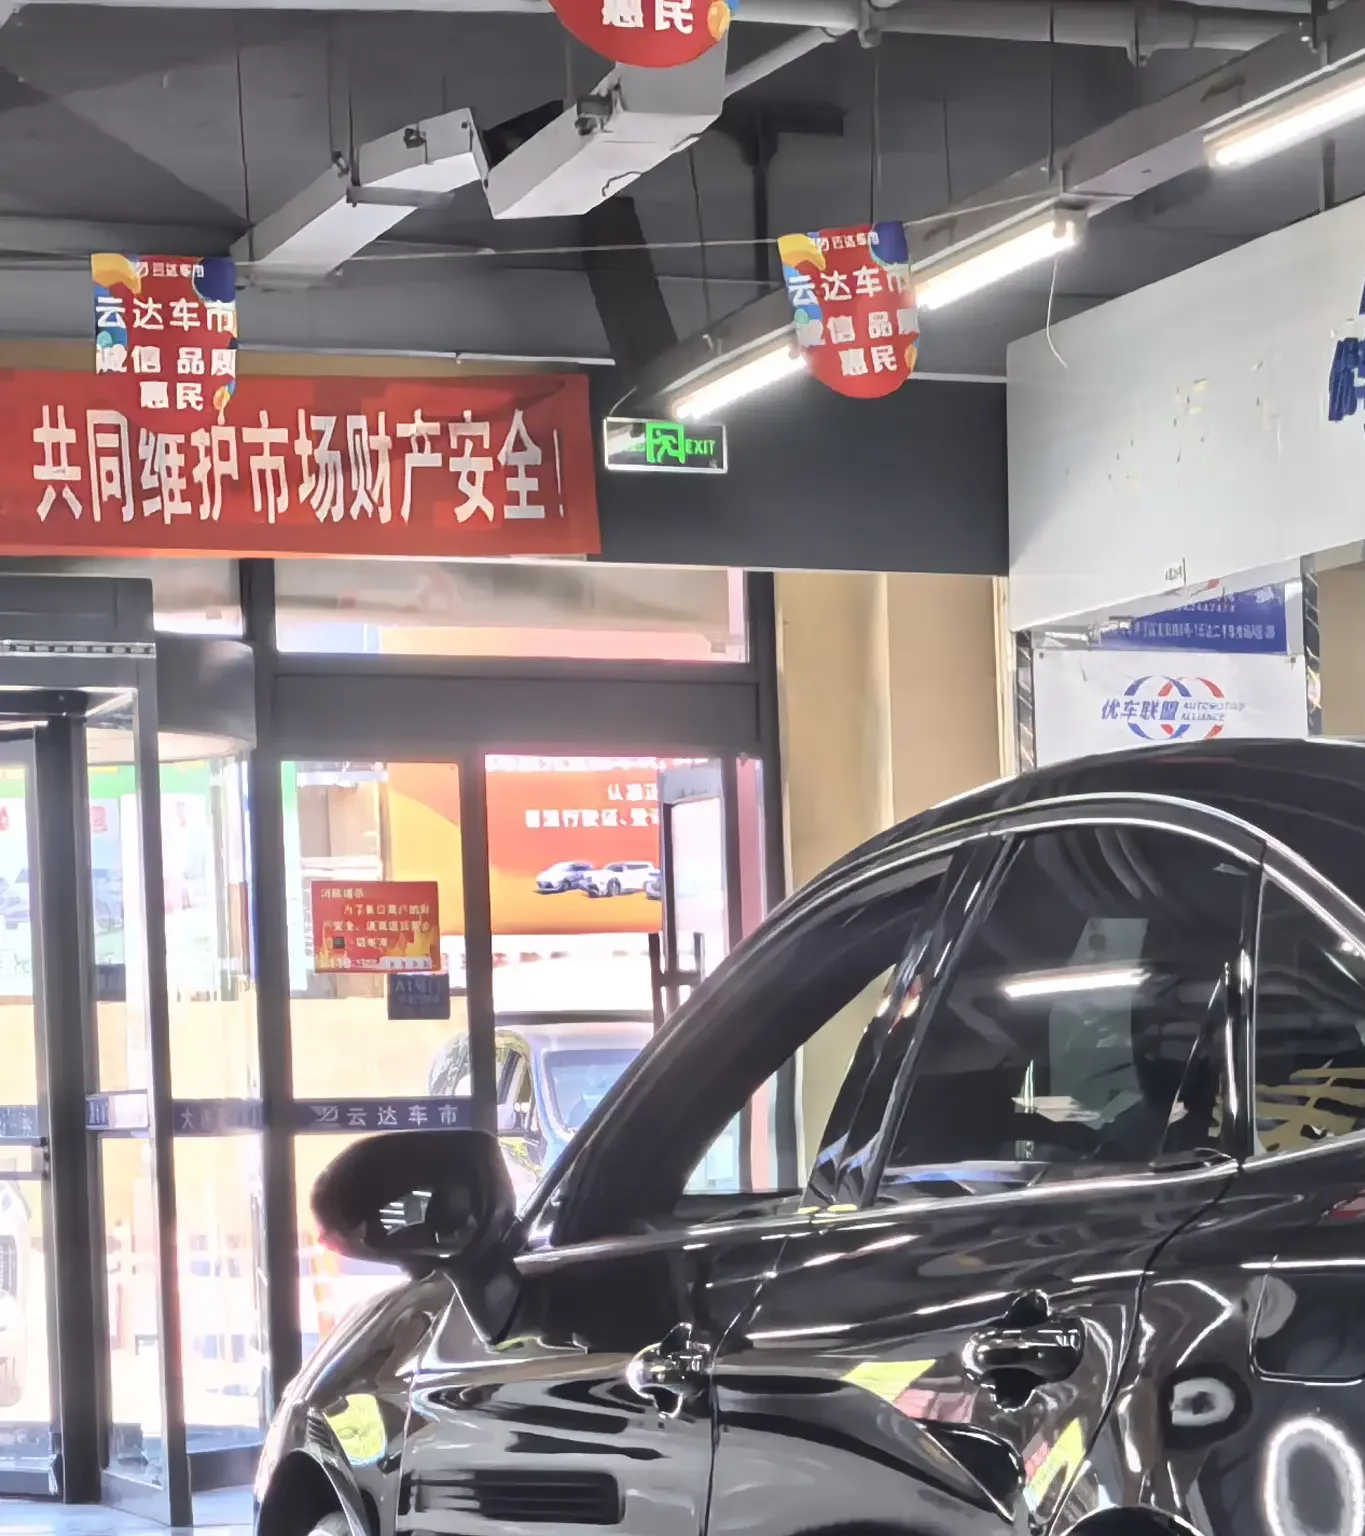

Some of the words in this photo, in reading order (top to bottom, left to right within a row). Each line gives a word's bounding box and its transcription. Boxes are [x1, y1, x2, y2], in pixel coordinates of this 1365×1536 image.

[788, 265, 911, 306] 云达车市
[96, 297, 237, 333] 云达车市
[685, 438, 716, 456] EXIT
[1101, 698, 1180, 721] 优车联盟
[346, 1104, 458, 1126] 云达车市
